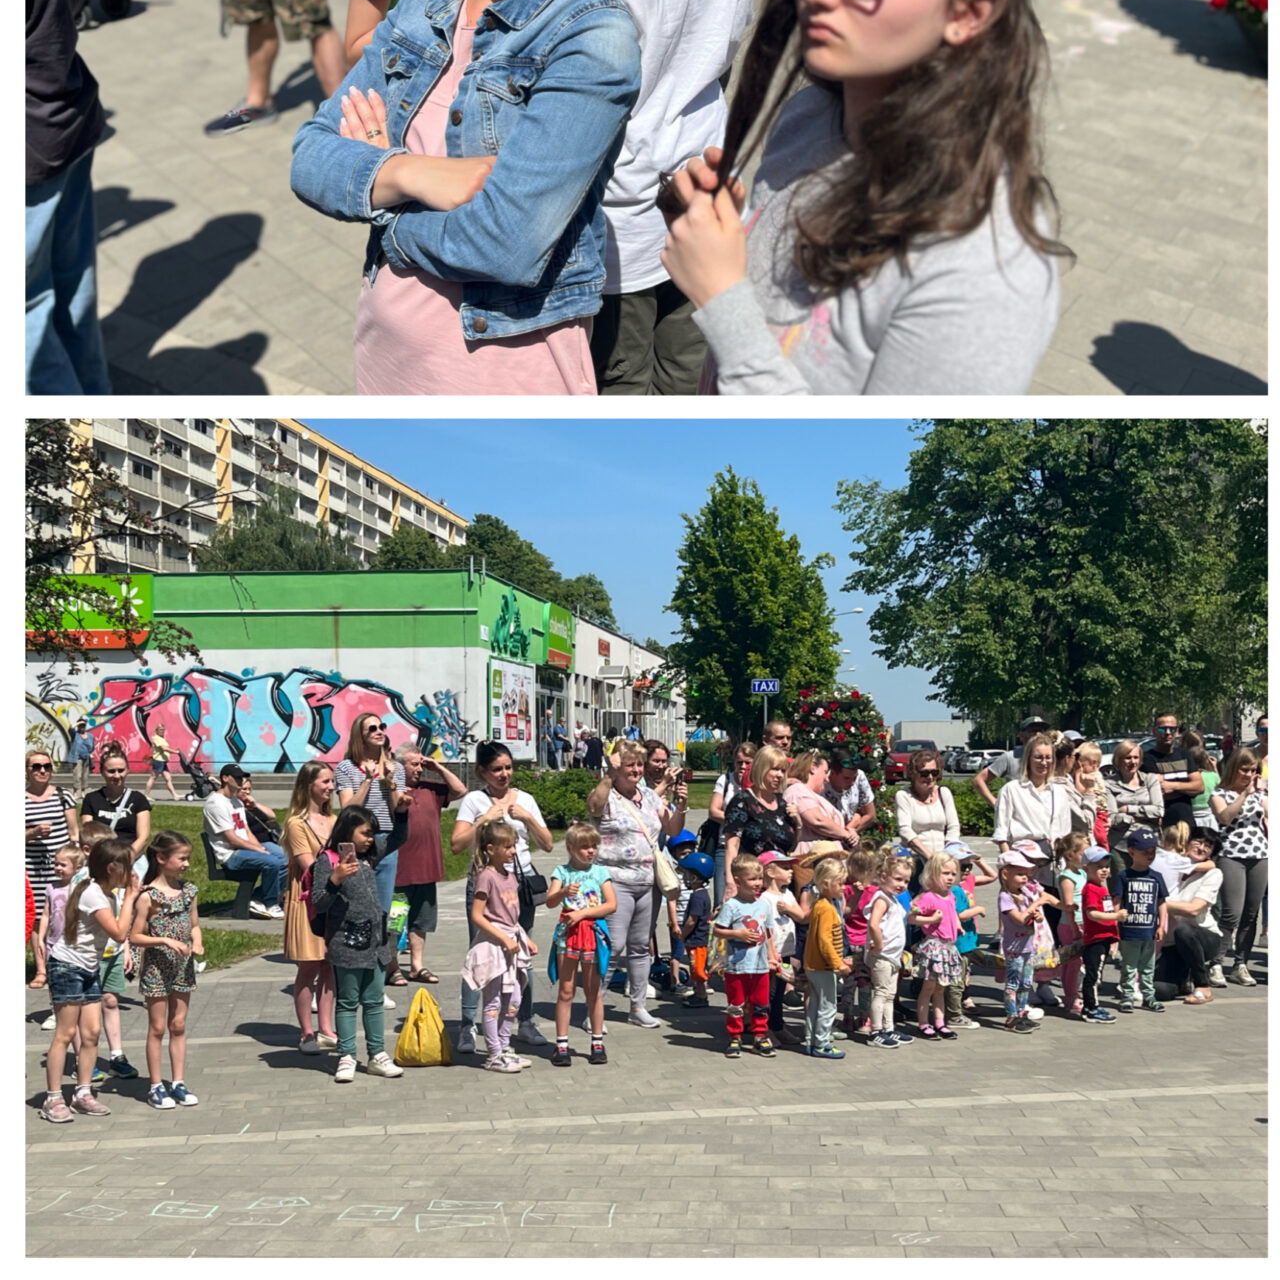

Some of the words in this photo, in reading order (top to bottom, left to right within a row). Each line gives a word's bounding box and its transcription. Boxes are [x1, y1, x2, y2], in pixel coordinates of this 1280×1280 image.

[753, 681, 778, 692] TAXI
[1132, 881, 1154, 893] WANT
[1128, 893, 1138, 903] TO
[1139, 893, 1154, 904] SEE
[1132, 903, 1148, 914] THE
[1127, 914, 1153, 925] WORLD
